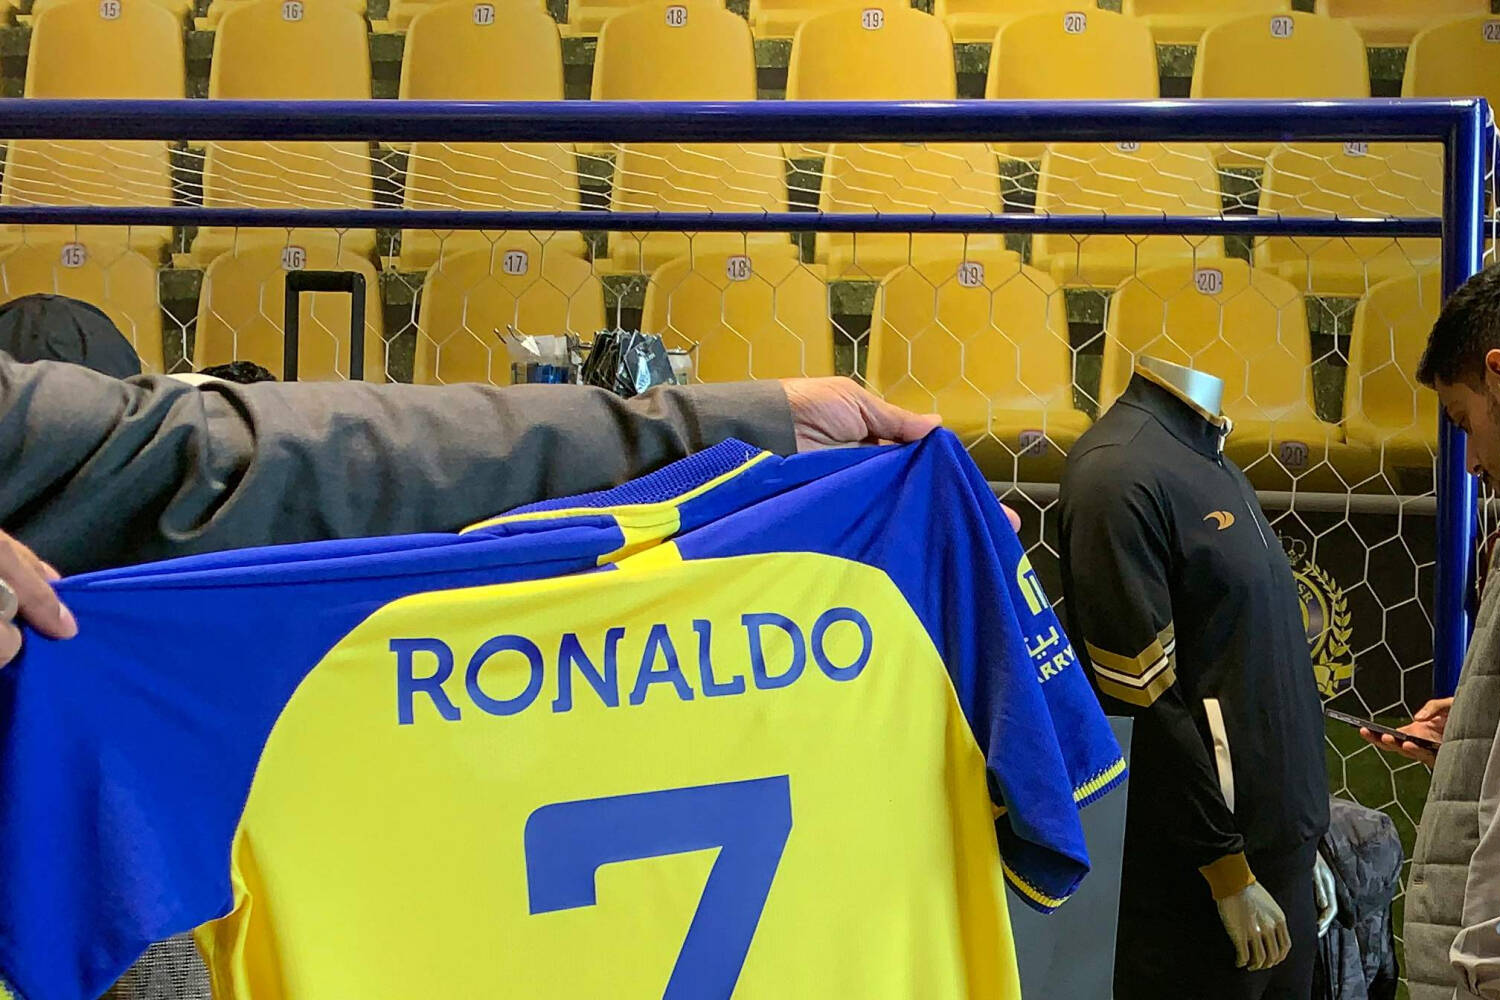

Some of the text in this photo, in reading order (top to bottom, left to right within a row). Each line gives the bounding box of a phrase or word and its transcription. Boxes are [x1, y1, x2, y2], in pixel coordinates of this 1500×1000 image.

[103, 2, 116, 17] 15
[286, 4, 298, 19] 16
[477, 7, 490, 23] 17
[670, 9, 682, 24] 18
[866, 12, 879, 28] 19
[1067, 16, 1081, 32] 20
[1274, 19, 1287, 35] 21
[66, 248, 80, 265] 15
[287, 250, 300, 268] 16
[508, 255, 523, 272] 17
[732, 260, 746, 277] 18
[963, 266, 978, 284] 19
[1199, 273, 1216, 291] 20
[389, 607, 872, 725] RONALDO
